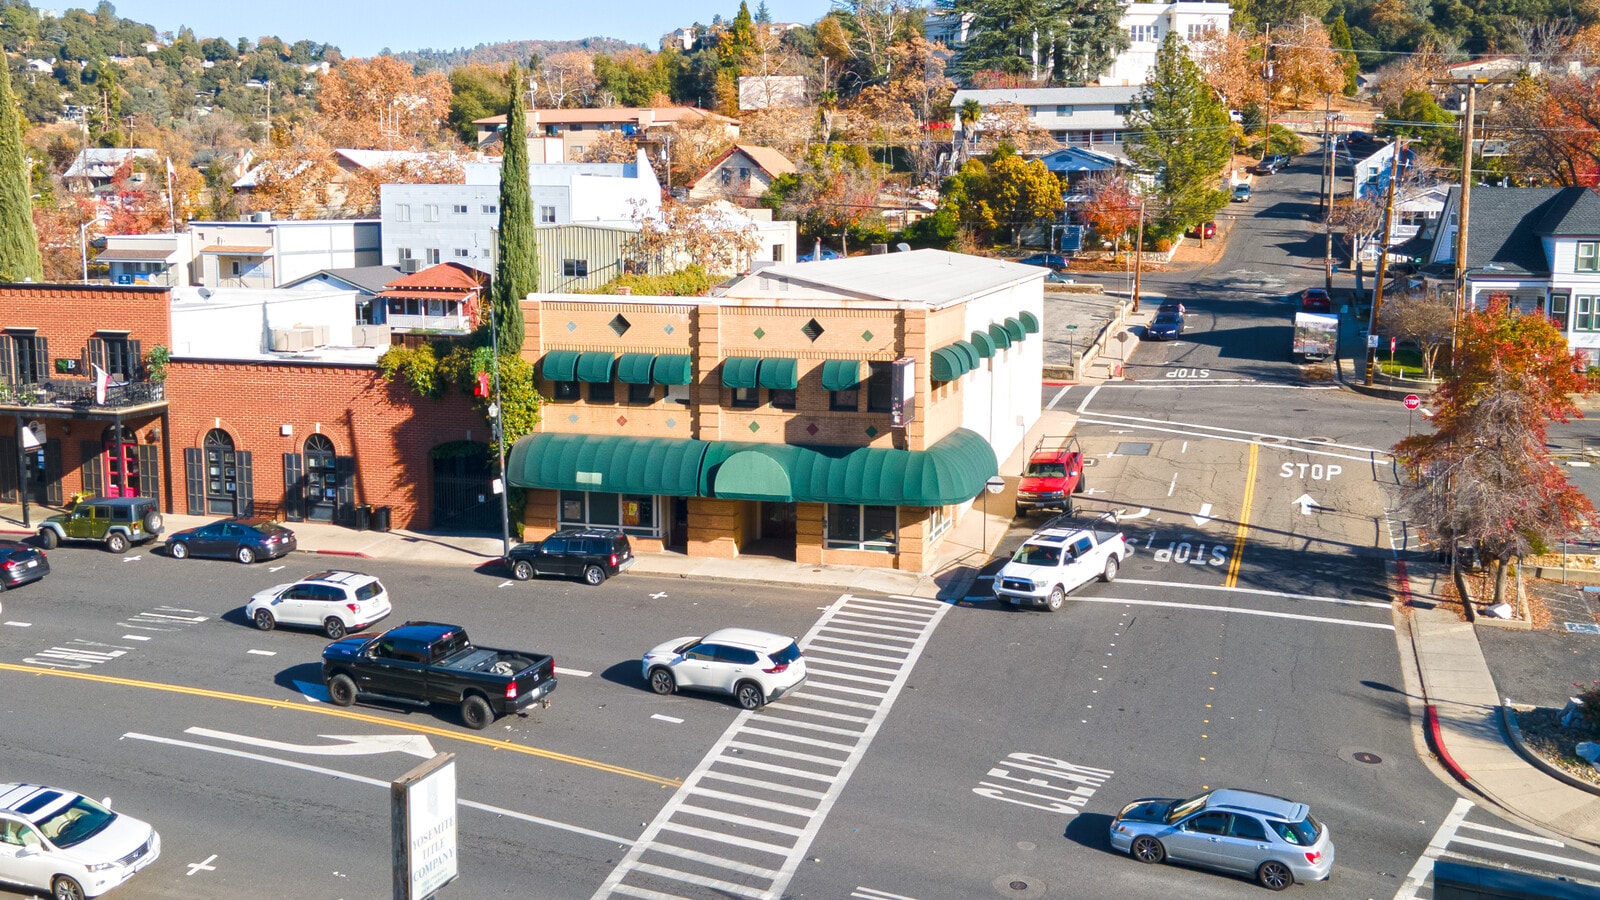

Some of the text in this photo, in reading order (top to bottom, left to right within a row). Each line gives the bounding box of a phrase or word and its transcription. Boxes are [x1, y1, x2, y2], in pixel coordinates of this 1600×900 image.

[1165, 368, 1210, 378] STOP
[1279, 462, 1342, 481] STOP
[1153, 541, 1228, 567] STOP
[972, 752, 1115, 815] CLEAR
[412, 817, 454, 850] YOSEMITE
[422, 838, 445, 860] TITLE
[413, 847, 454, 881] COMPANY
